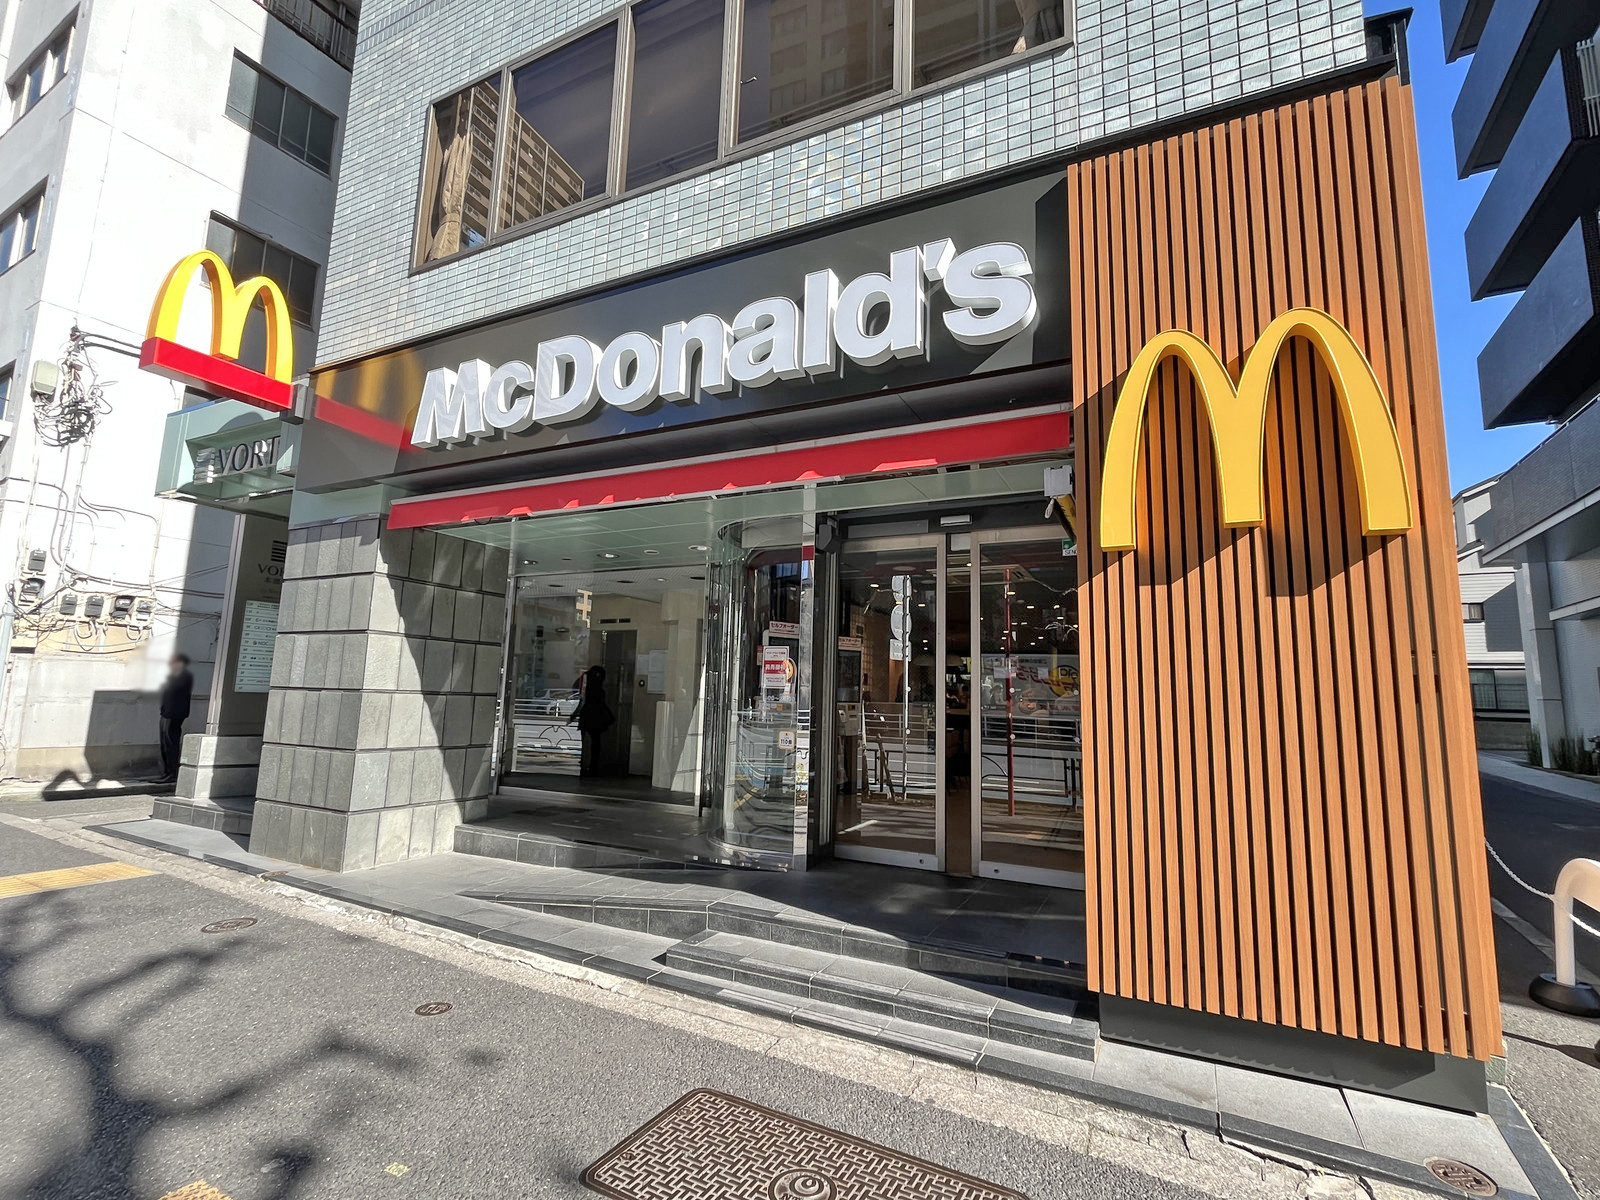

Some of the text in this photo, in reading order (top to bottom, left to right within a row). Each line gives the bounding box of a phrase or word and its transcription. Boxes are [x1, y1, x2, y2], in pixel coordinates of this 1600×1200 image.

[410, 238, 1037, 448] McDonald's
[218, 435, 281, 475] VORT
[258, 563, 284, 577] VO
